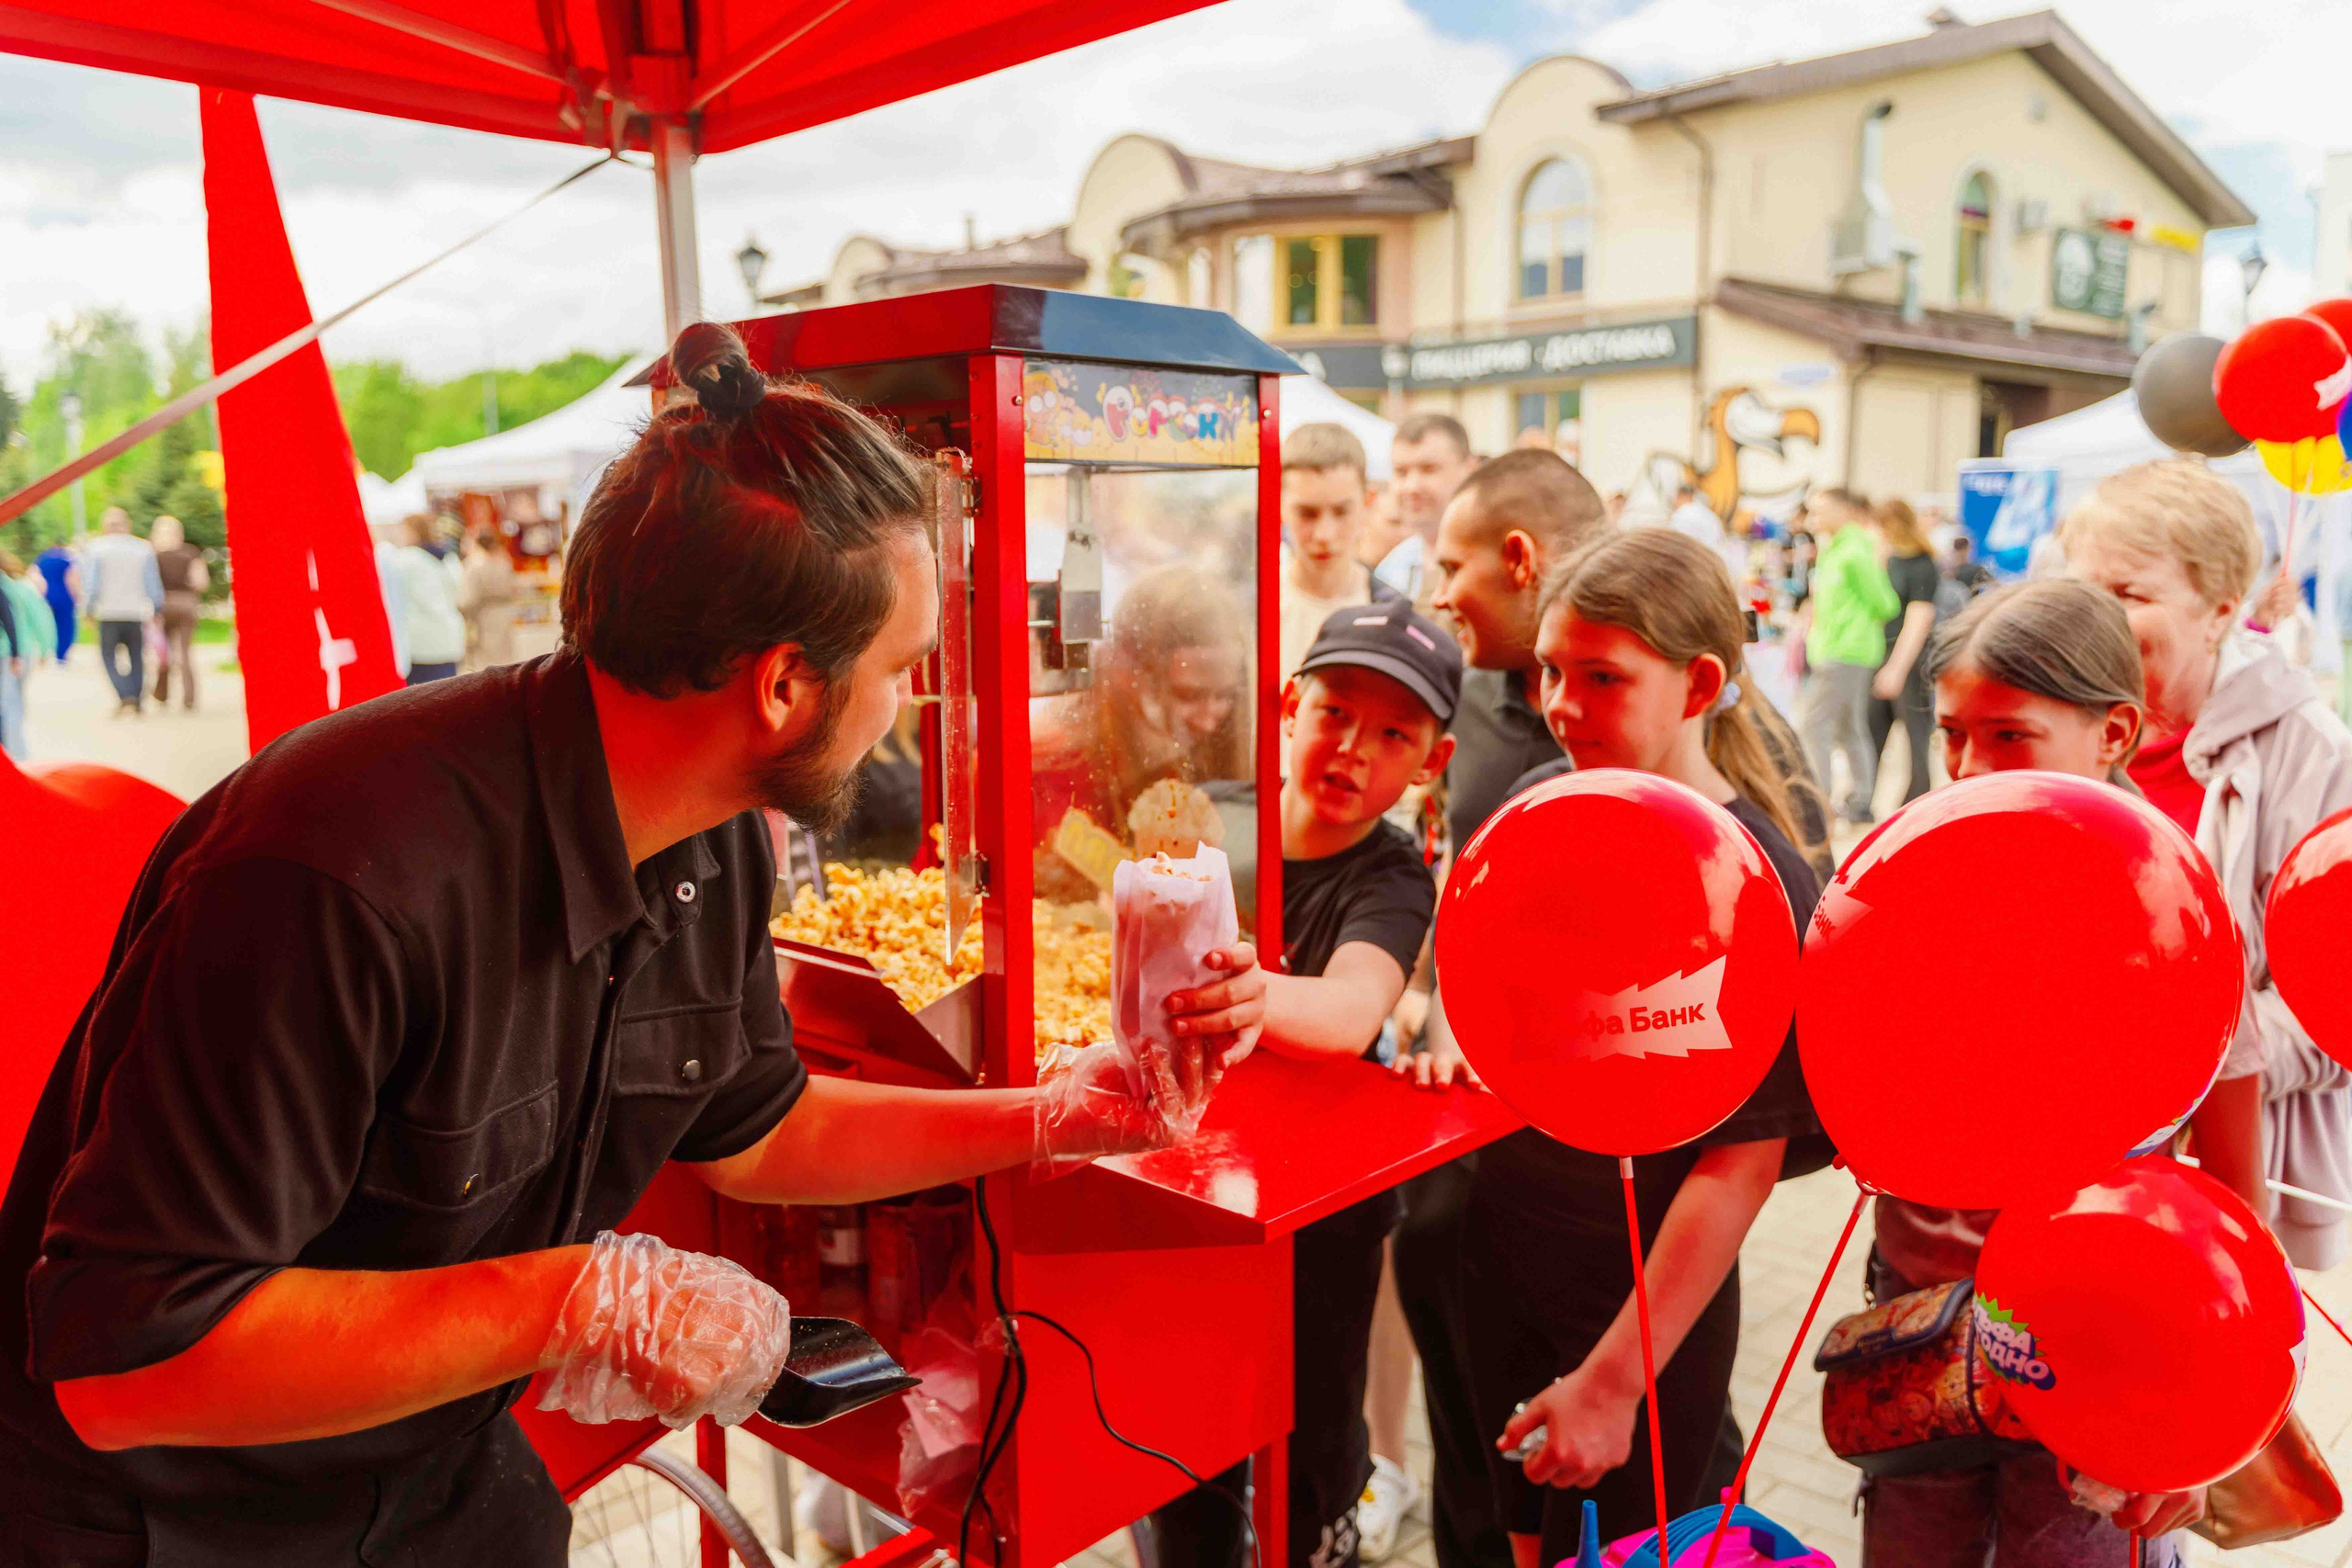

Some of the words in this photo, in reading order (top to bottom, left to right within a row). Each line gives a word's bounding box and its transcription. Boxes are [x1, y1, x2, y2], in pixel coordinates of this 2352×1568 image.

[1543, 324, 1676, 373] ДОСТАВКА
[1629, 1002, 1706, 1033] Банк
[1976, 1323, 2050, 1380] ОДНО
